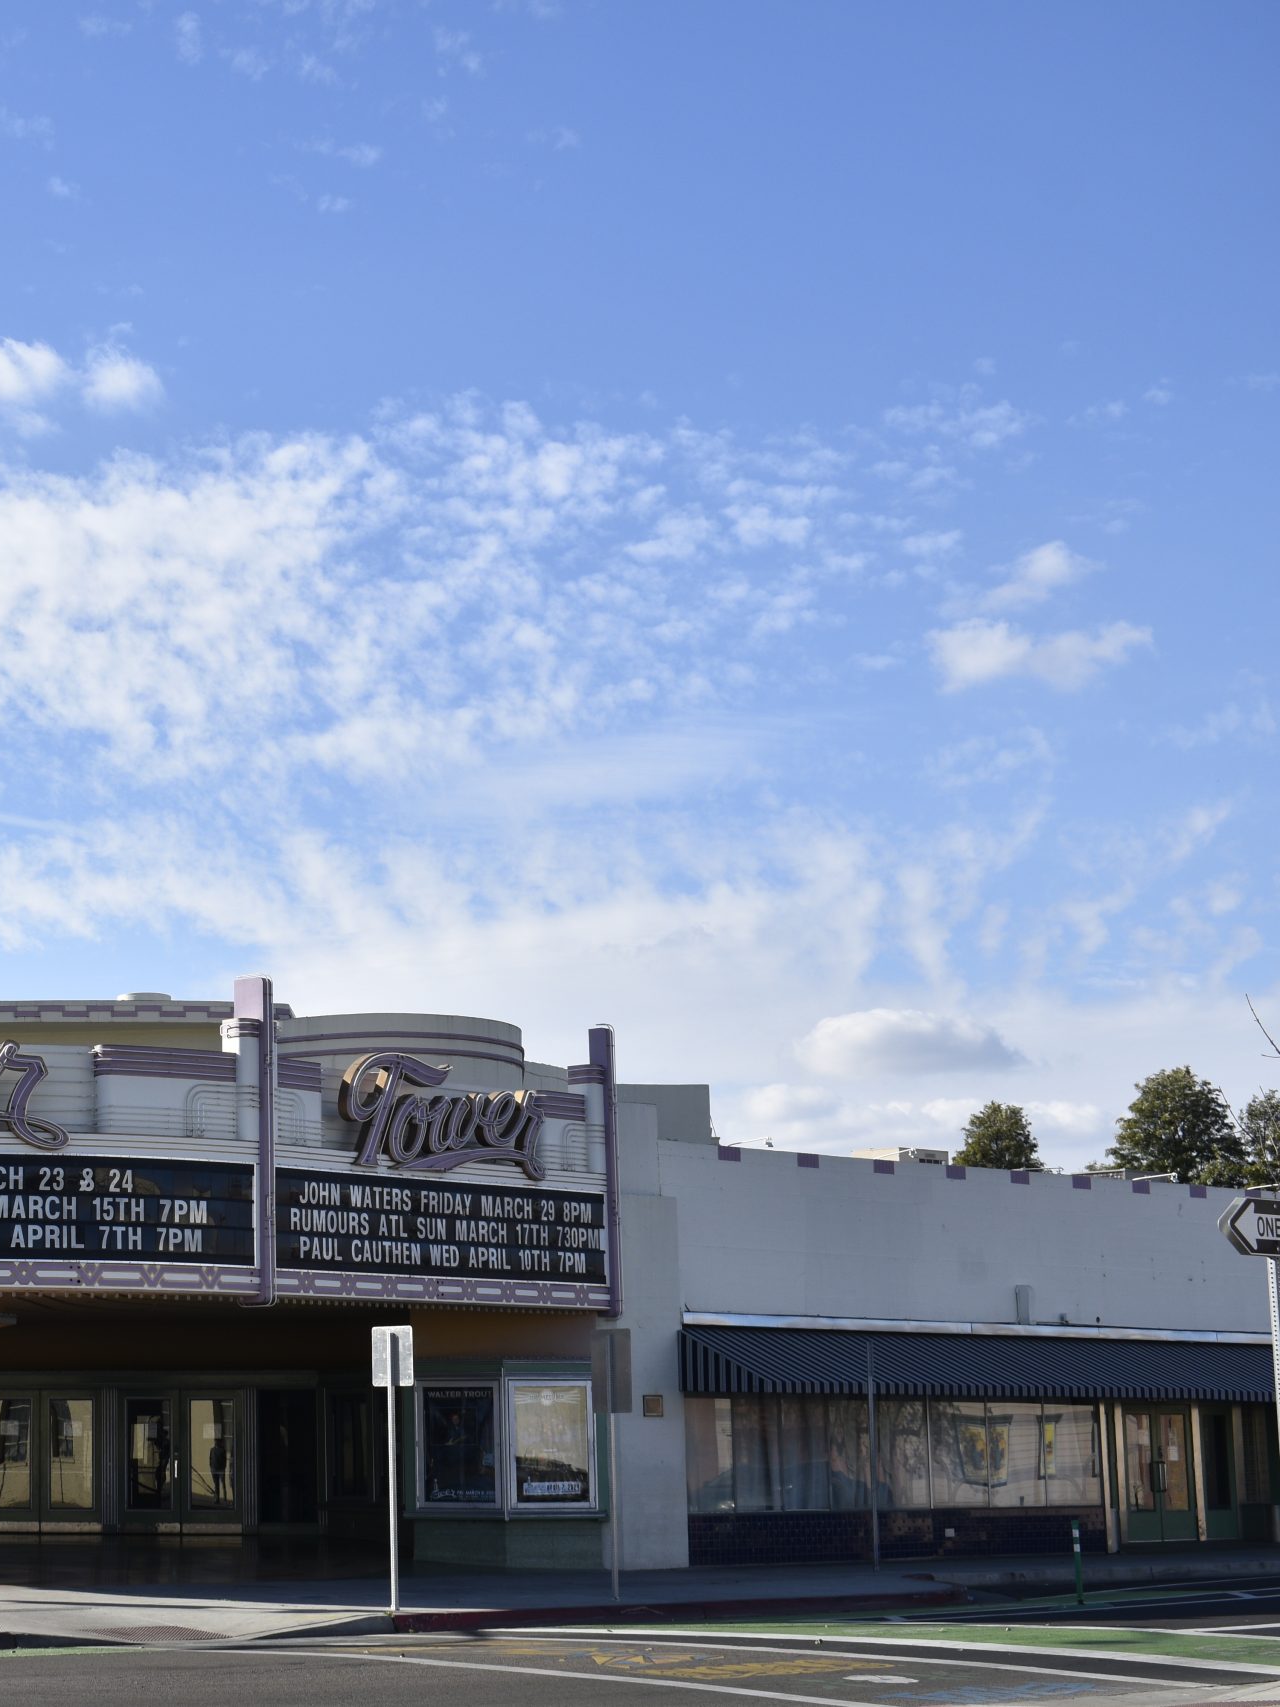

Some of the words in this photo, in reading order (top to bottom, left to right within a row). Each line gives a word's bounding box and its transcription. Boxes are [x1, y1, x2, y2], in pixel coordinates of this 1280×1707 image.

[338, 1052, 548, 1181] Tower
[38, 1166, 64, 1191] 23
[80, 1168, 94, 1192] &
[109, 1169, 134, 1193] 24
[92, 1197, 145, 1222] 15TH
[160, 1199, 208, 1224] 7PM
[299, 1182, 341, 1207] JOHN
[350, 1185, 412, 1212] WATERS
[420, 1190, 472, 1216] FRIDAY
[481, 1195, 532, 1220] MARCH
[540, 1200, 556, 1221] 29
[563, 1201, 592, 1224] 8PM
[11, 1224, 85, 1249] APRIL
[99, 1226, 142, 1251] 7TH
[157, 1227, 202, 1252] 7PM
[290, 1208, 370, 1236] RUMOURS
[378, 1214, 408, 1238] ATL
[416, 1217, 446, 1241] SUN
[456, 1220, 507, 1244] MARCH
[516, 1224, 549, 1247] 17TH
[556, 1226, 600, 1250] 730PM
[1257, 1216, 1280, 1238] ONE
[299, 1236, 342, 1262] PAUL
[351, 1240, 420, 1266] CAUTHEN
[430, 1244, 460, 1268] WED
[468, 1247, 511, 1271] APRIL
[518, 1250, 550, 1272] 10TH
[558, 1252, 586, 1274] 7PM
